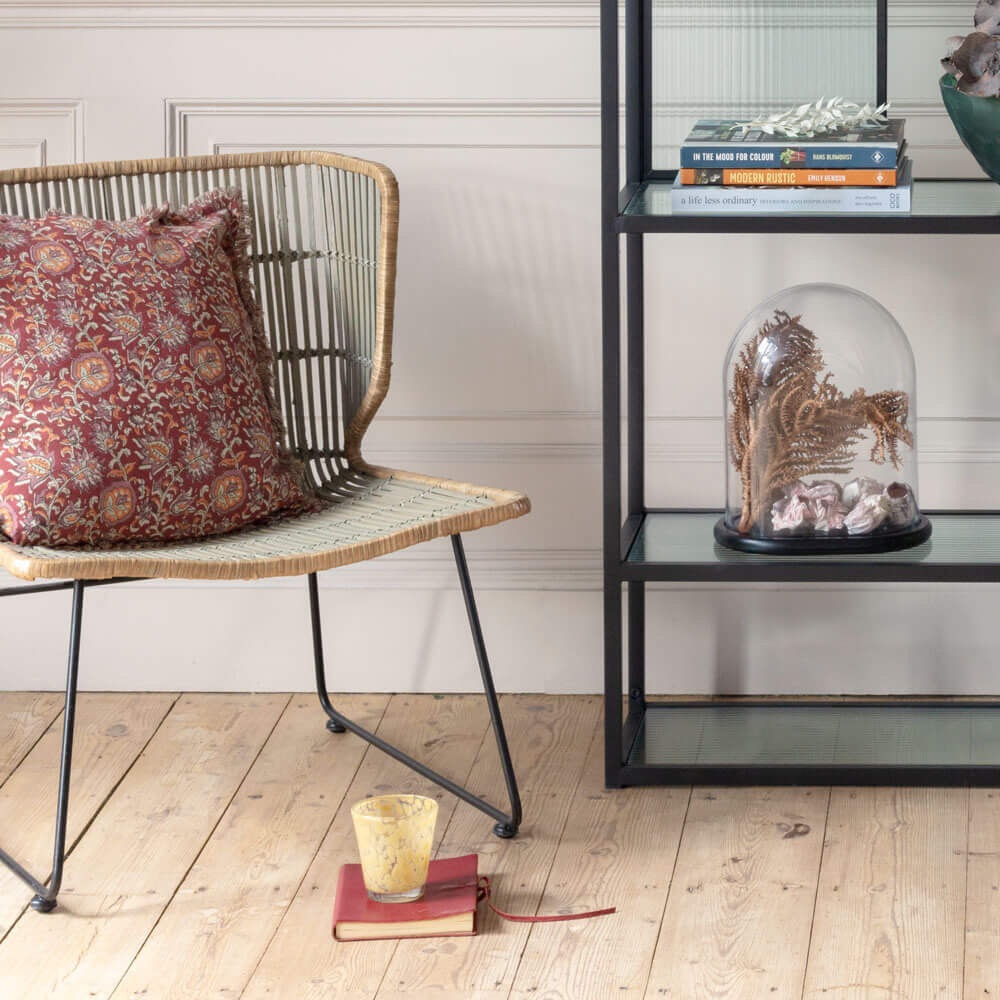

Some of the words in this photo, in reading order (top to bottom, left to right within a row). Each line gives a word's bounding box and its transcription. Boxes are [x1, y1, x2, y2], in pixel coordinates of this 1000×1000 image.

[693, 152, 701, 161] IN
[702, 152, 714, 161] THE
[715, 152, 735, 161] MOOD
[736, 152, 748, 161] FOR
[749, 152, 774, 161] COLOUR
[729, 172, 765, 184] MODERN
[766, 172, 797, 184] RUSTIC
[688, 195, 702, 205] life
[704, 195, 720, 205] less
[722, 195, 758, 207] ordinary
